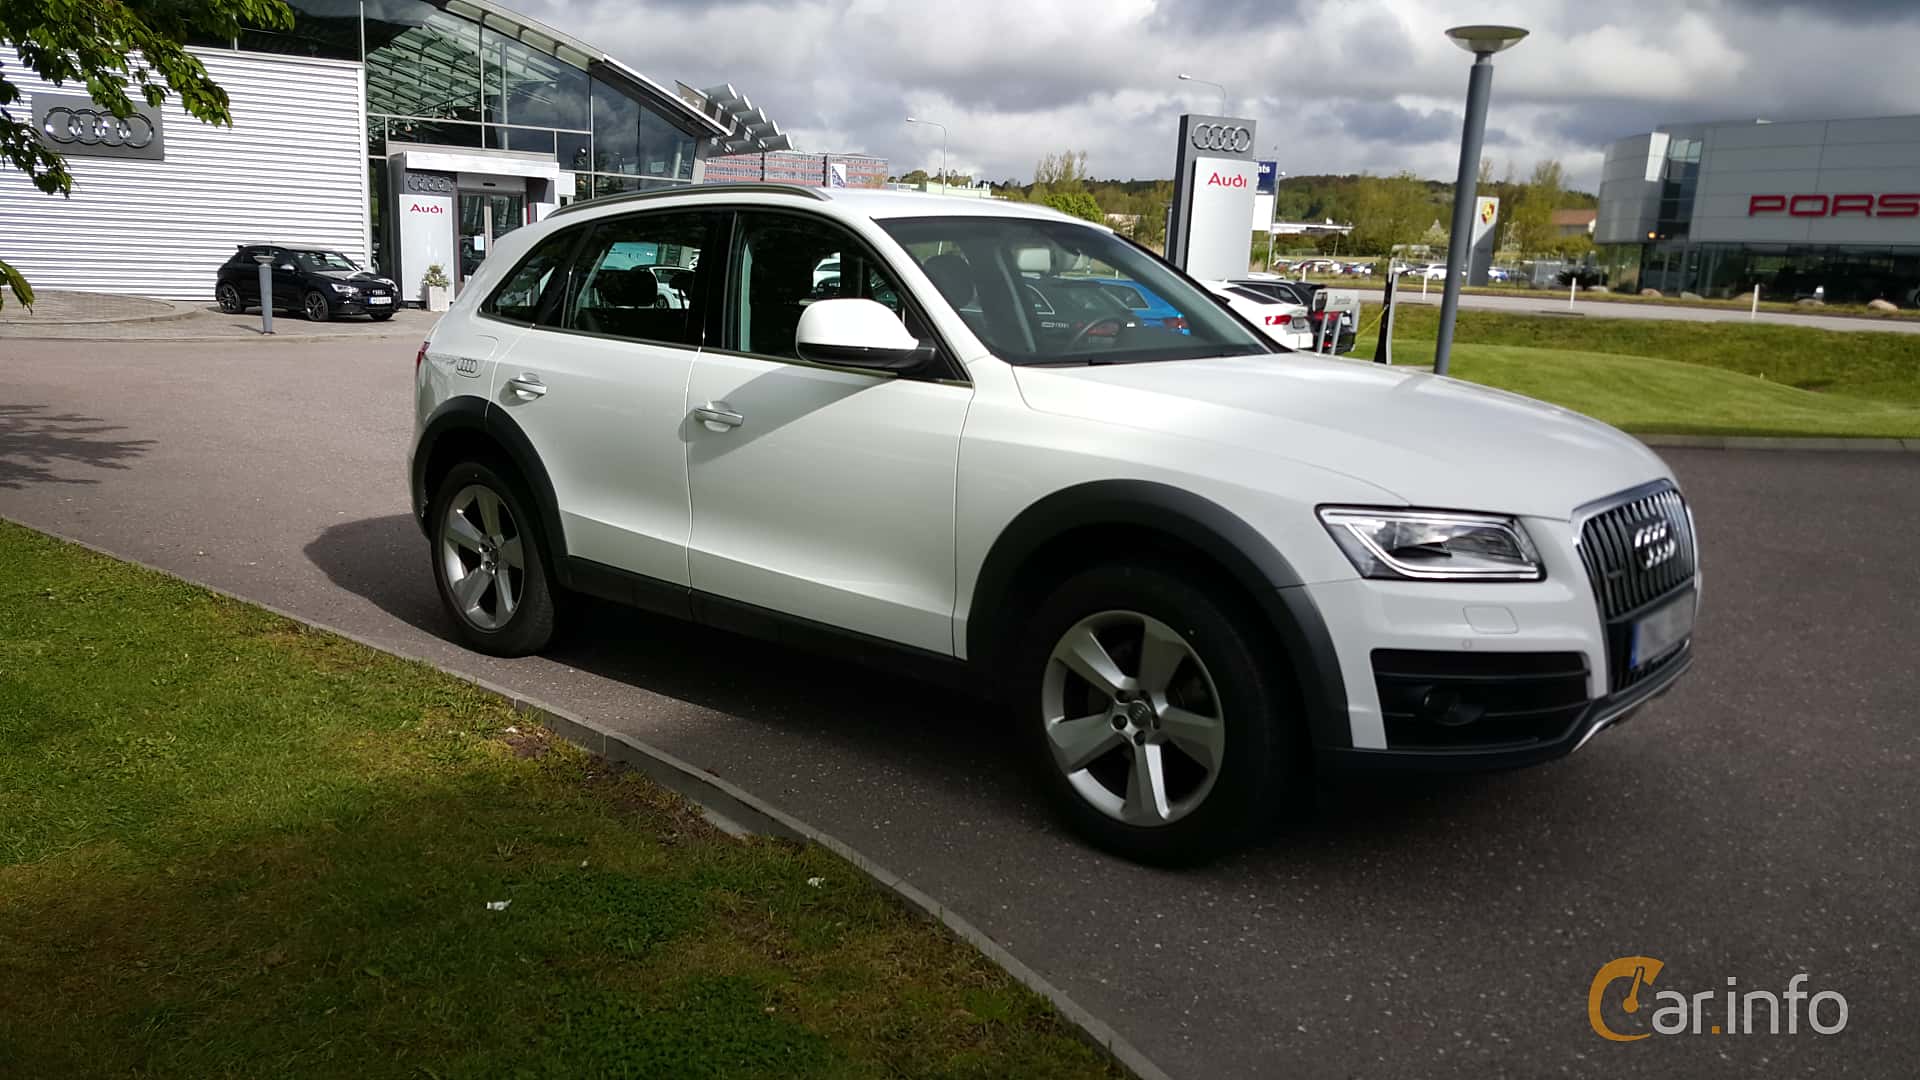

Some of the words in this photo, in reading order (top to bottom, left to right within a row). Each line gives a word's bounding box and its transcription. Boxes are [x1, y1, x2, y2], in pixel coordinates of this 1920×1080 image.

[1208, 172, 1247, 188] Audi
[410, 203, 443, 214] Audi
[1748, 194, 1920, 217] PORS
